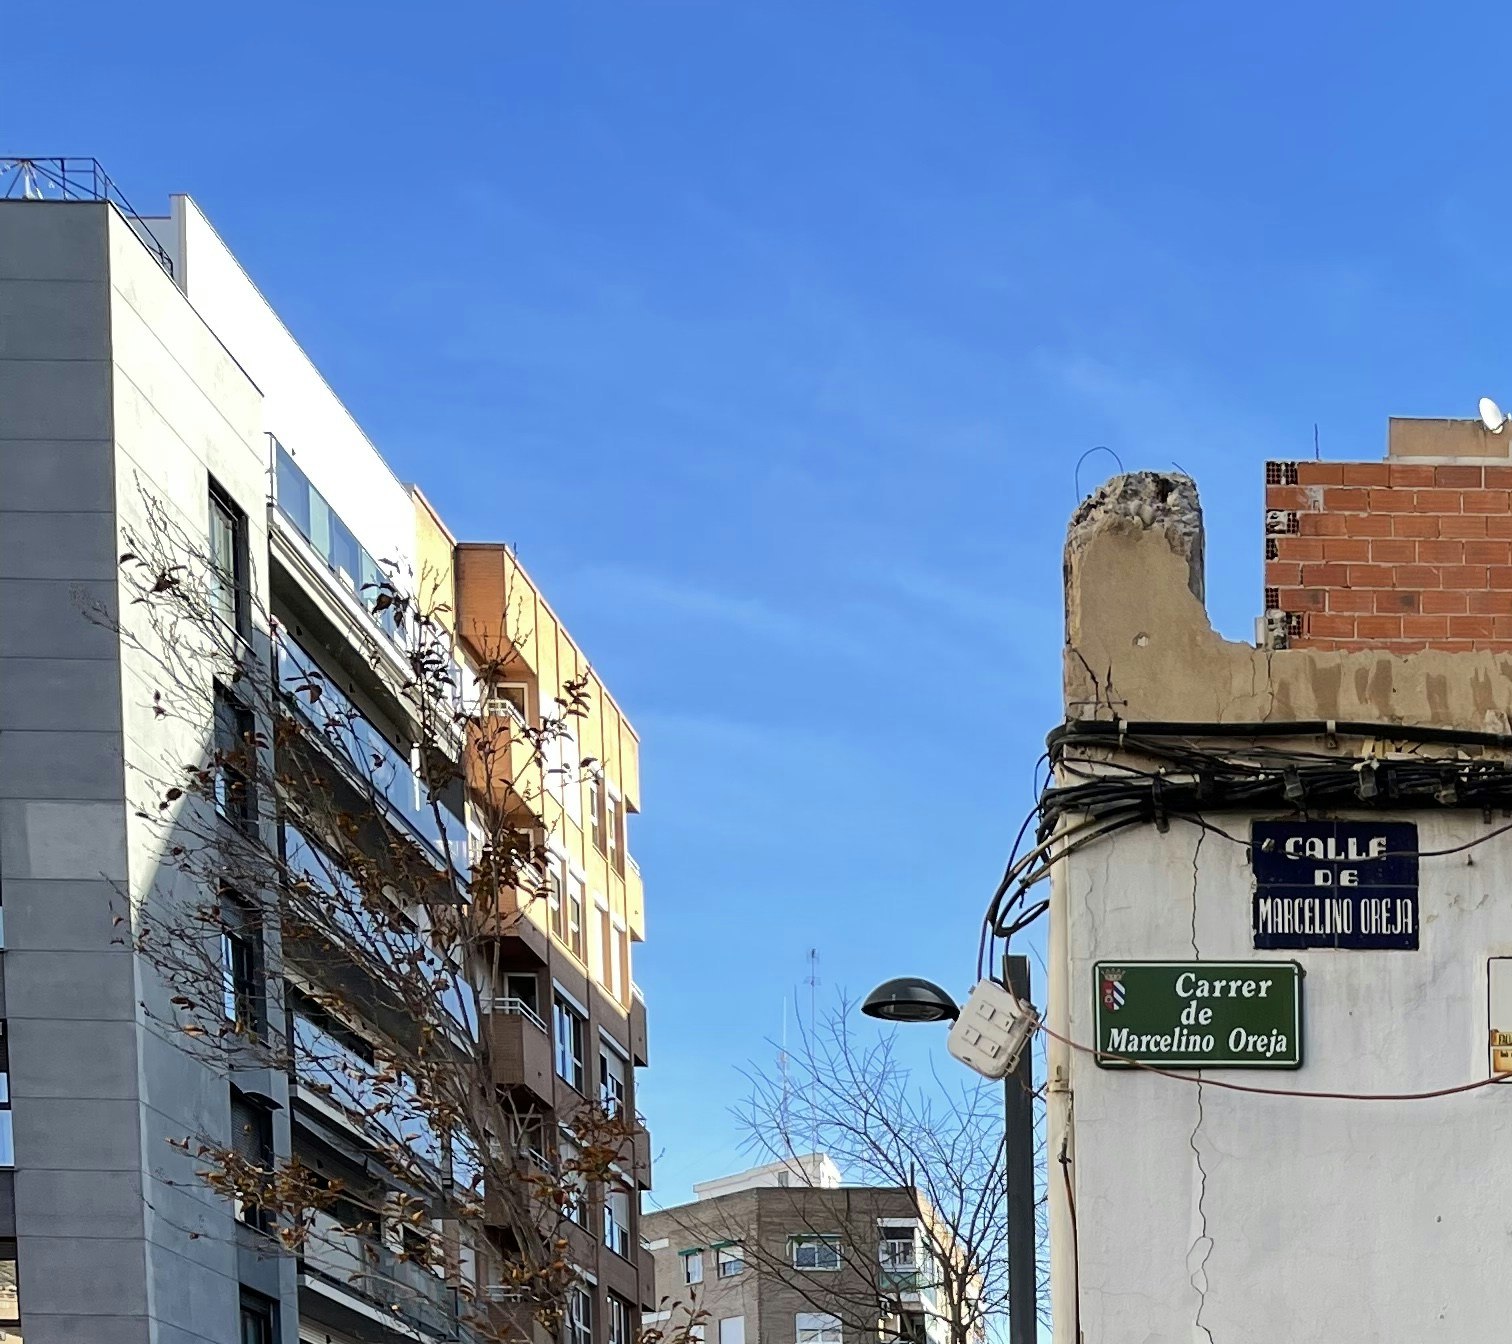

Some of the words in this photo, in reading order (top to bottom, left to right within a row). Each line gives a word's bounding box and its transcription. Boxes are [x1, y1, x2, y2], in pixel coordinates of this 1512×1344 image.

[1285, 836, 1387, 861] CALLE
[1314, 869, 1359, 887] DE
[1259, 897, 1353, 935] MARCELINO
[1360, 898, 1413, 935] OREJA
[1175, 972, 1273, 998] Carrer
[1180, 1000, 1213, 1025] de
[1107, 1027, 1215, 1053] Marcelino
[1228, 1027, 1288, 1058] Oreja
